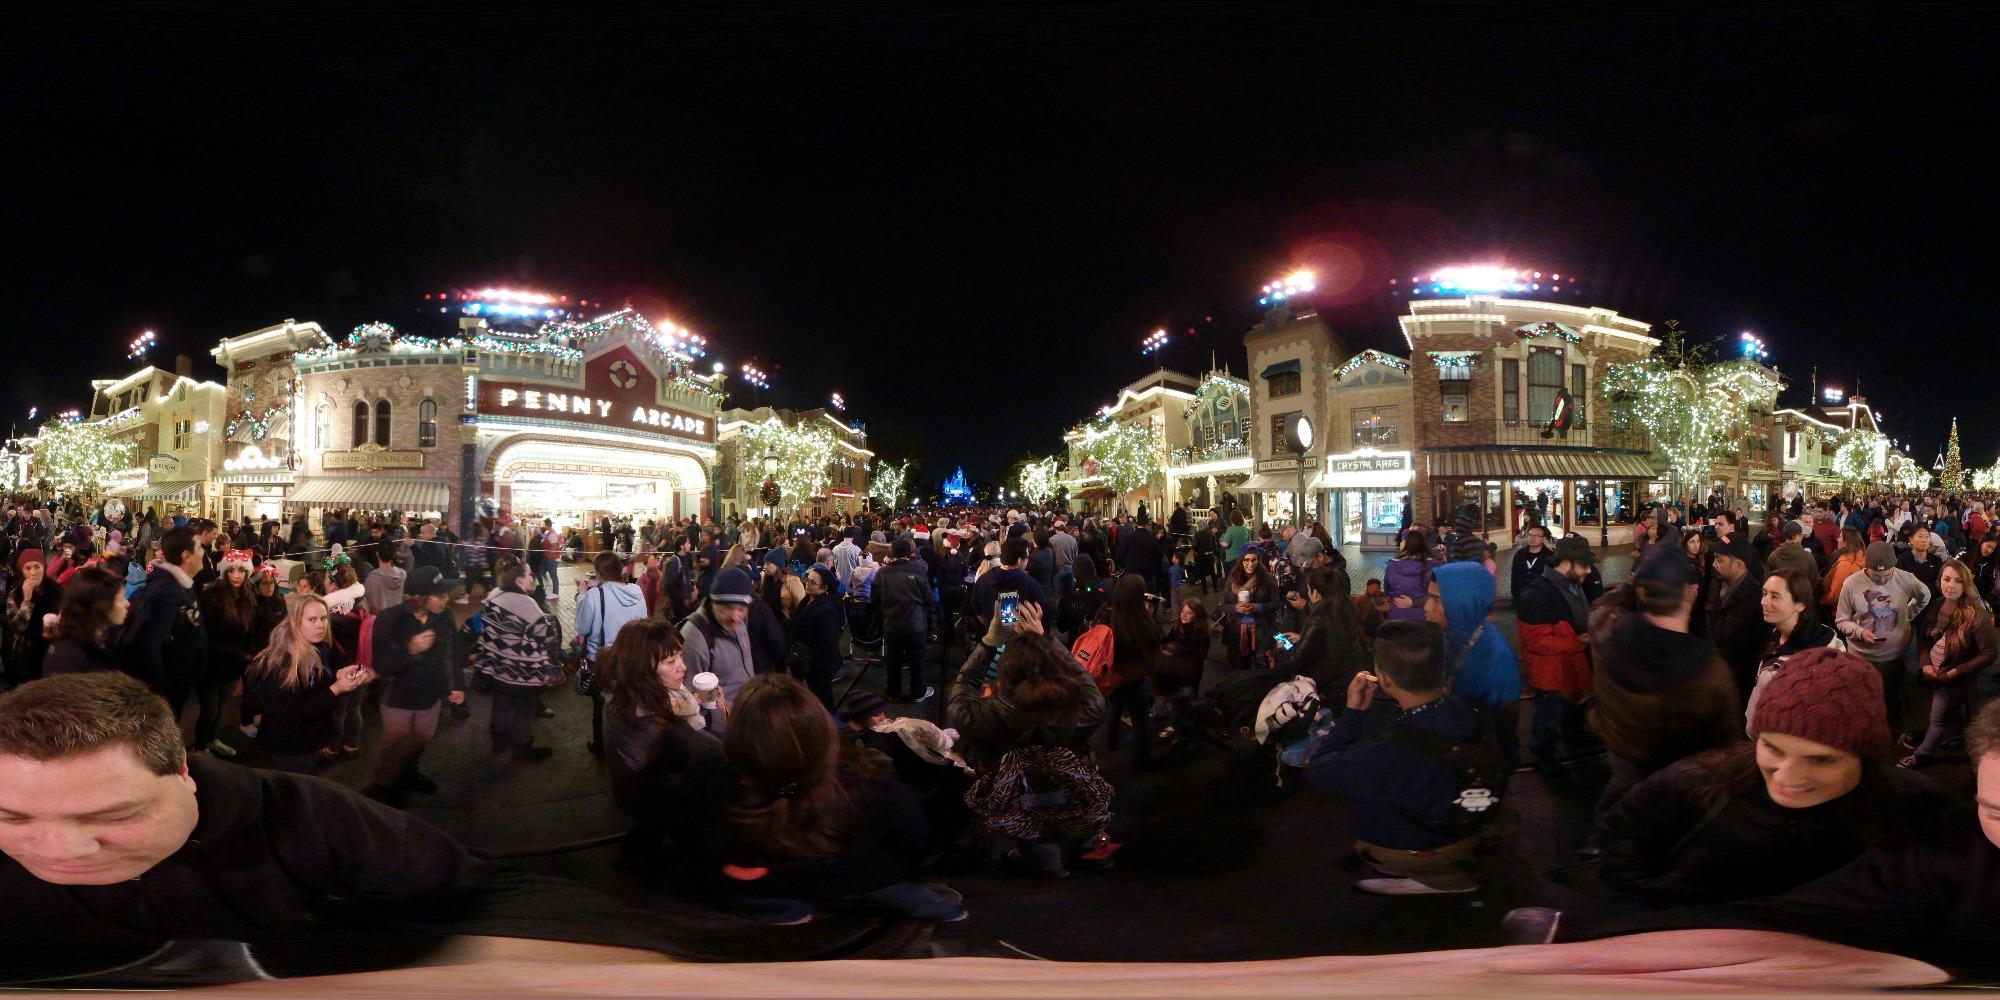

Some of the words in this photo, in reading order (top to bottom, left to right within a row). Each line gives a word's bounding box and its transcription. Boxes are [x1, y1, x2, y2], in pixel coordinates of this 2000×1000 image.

[500, 388, 612, 417] PENNY
[632, 406, 705, 435] ARCADE
[341, 455, 374, 463] CREAM
[1337, 460, 1373, 471] CRYSTAL
[1375, 458, 1400, 469] ARTS
